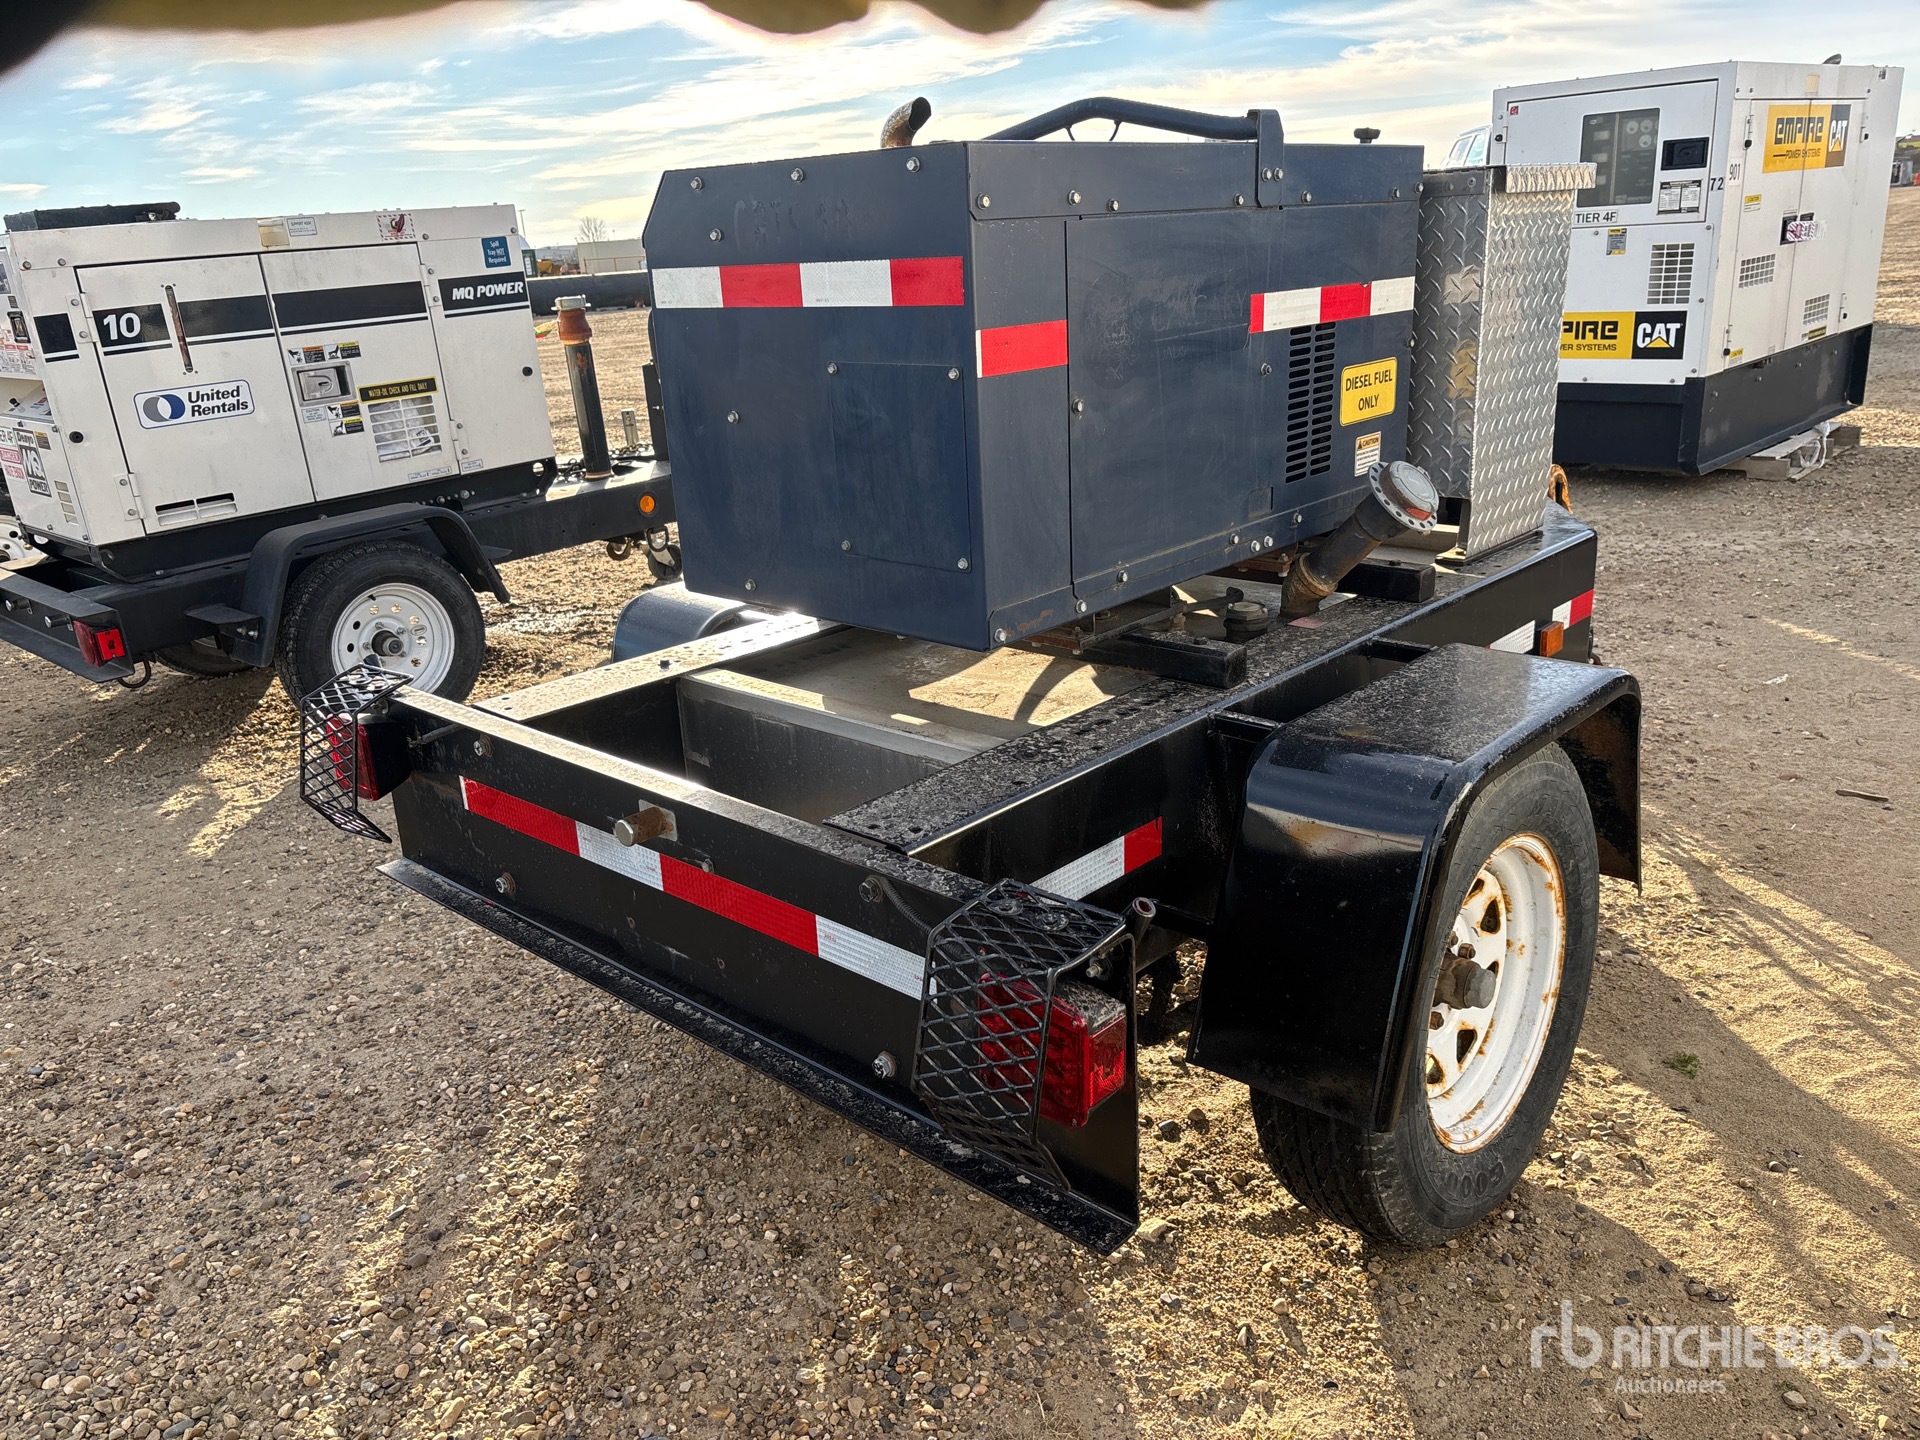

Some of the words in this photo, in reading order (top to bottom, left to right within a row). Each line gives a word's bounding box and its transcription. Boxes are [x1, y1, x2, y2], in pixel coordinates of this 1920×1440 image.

[1774, 117, 1825, 145] EMPIRE
[1829, 120, 1848, 152] CAT
[1785, 149, 1801, 159] POWER
[1802, 148, 1821, 158] SYSTEMS
[1729, 163, 1741, 181] 901
[1710, 177, 1724, 191] 72
[1575, 212, 1600, 223] TIER
[1602, 211, 1617, 222] 4F
[489, 240, 500, 248] Spill
[487, 249, 496, 257] Tray
[496, 247, 505, 256] NOT
[488, 256, 507, 264] Required
[452, 286, 475, 301] MQ
[477, 281, 524, 298] POWER
[103, 312, 141, 340] 10
[1637, 323, 1681, 348] CAT
[1575, 343, 1617, 351] SYSTEMS
[1345, 374, 1373, 392] DIESEL
[1374, 369, 1393, 386] FUEL
[188, 385, 241, 404] United
[388, 385, 401, 395] CHECK
[401, 384, 409, 393] AND
[409, 383, 417, 392] FILL
[417, 382, 428, 390] DAILY
[191, 399, 249, 417] Rentals
[1358, 394, 1380, 411] ONLY
[16, 431, 35, 446] Denyo
[1363, 437, 1379, 447] CAUTION
[29, 479, 49, 493] POWER
